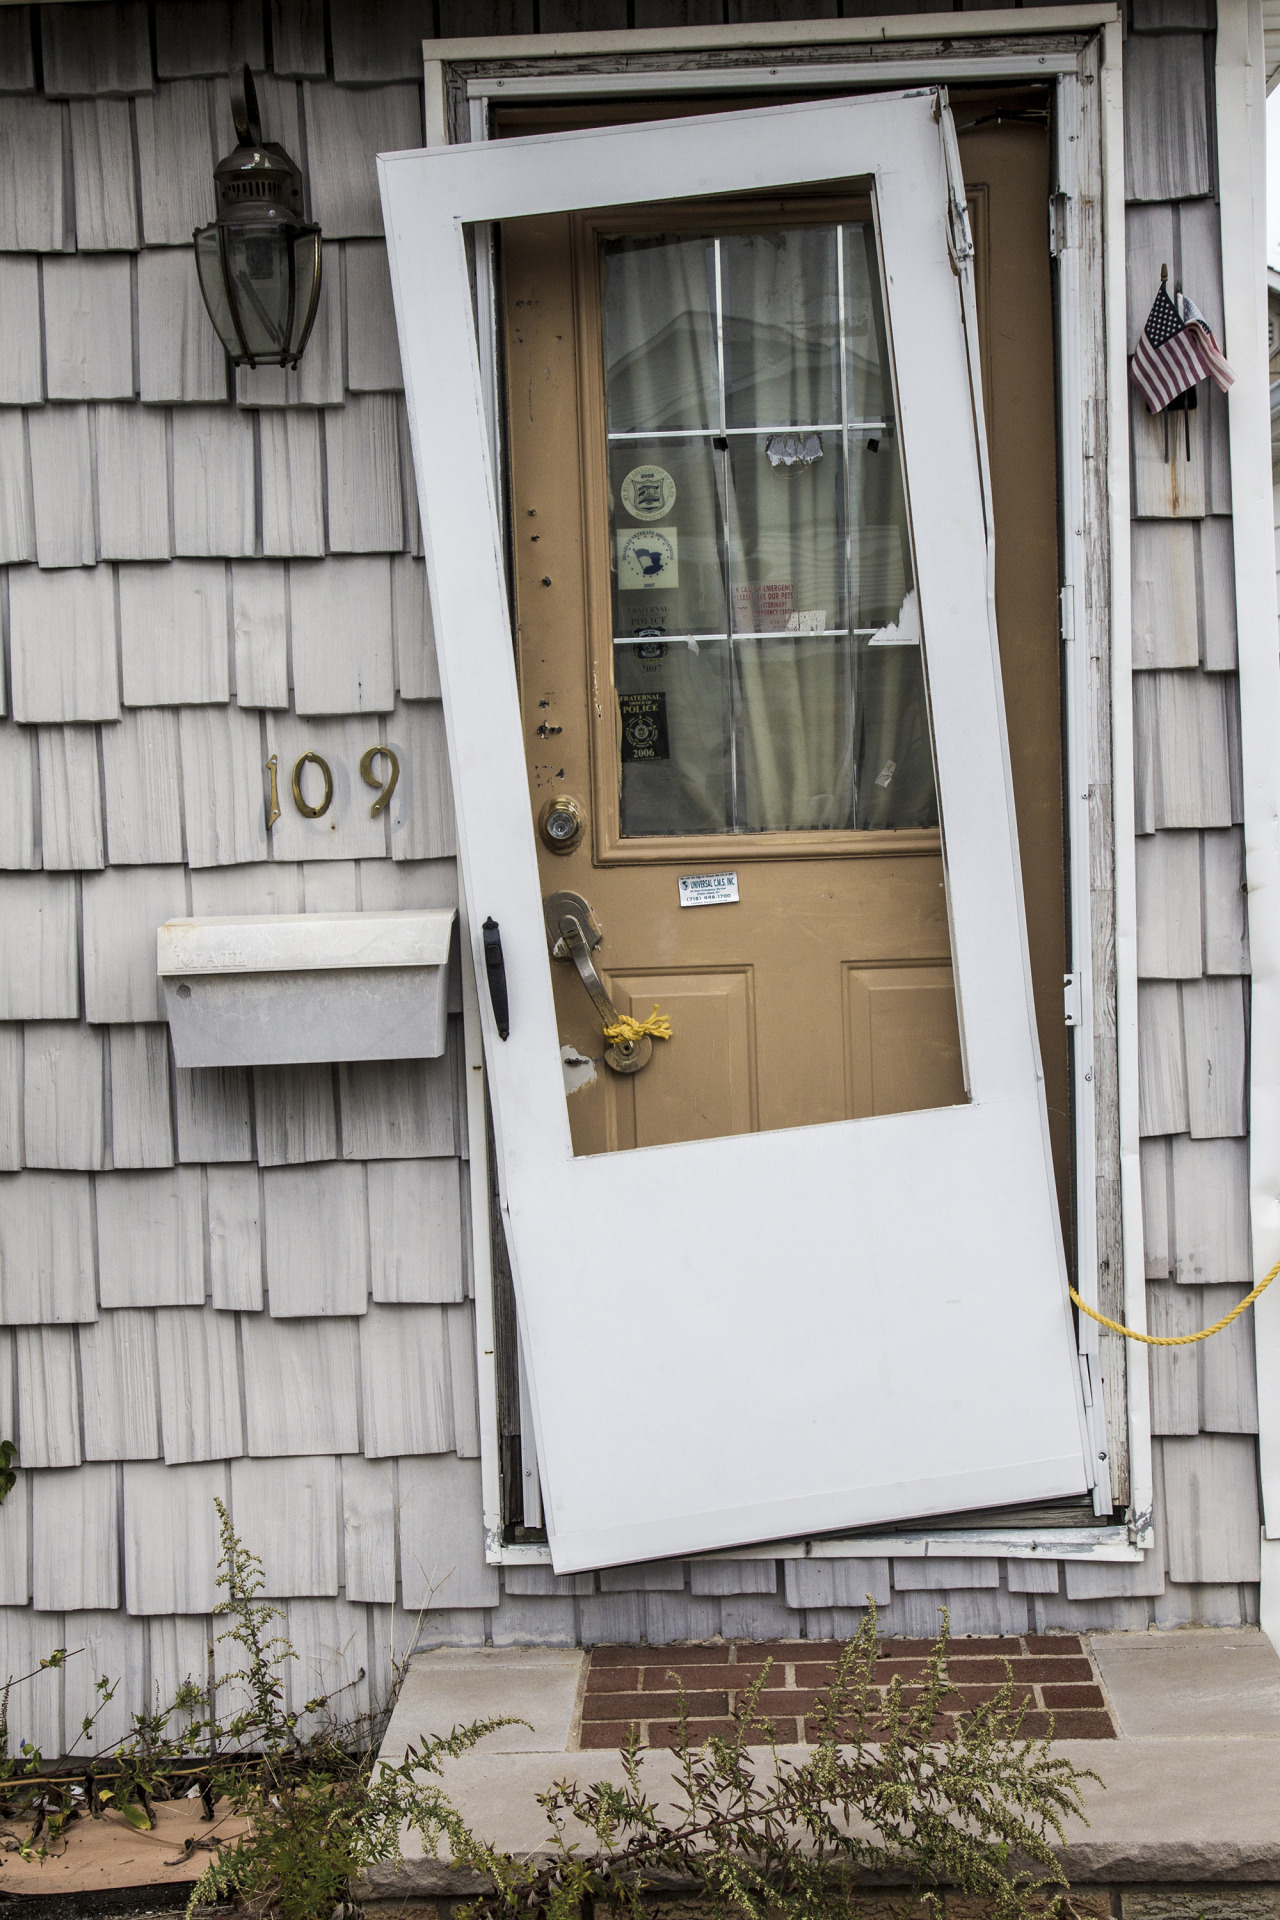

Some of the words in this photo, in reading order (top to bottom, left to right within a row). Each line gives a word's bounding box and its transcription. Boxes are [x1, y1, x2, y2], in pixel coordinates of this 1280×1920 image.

[632, 530, 654, 539] VETERANS
[631, 616, 667, 625] POLICE
[642, 664, 661, 673] 2007
[623, 704, 659, 713] POLICE
[633, 748, 655, 757] 2006
[265, 745, 399, 828] 109
[691, 880, 713, 889] UNIVERSAL
[175, 952, 248, 969] MAIL
